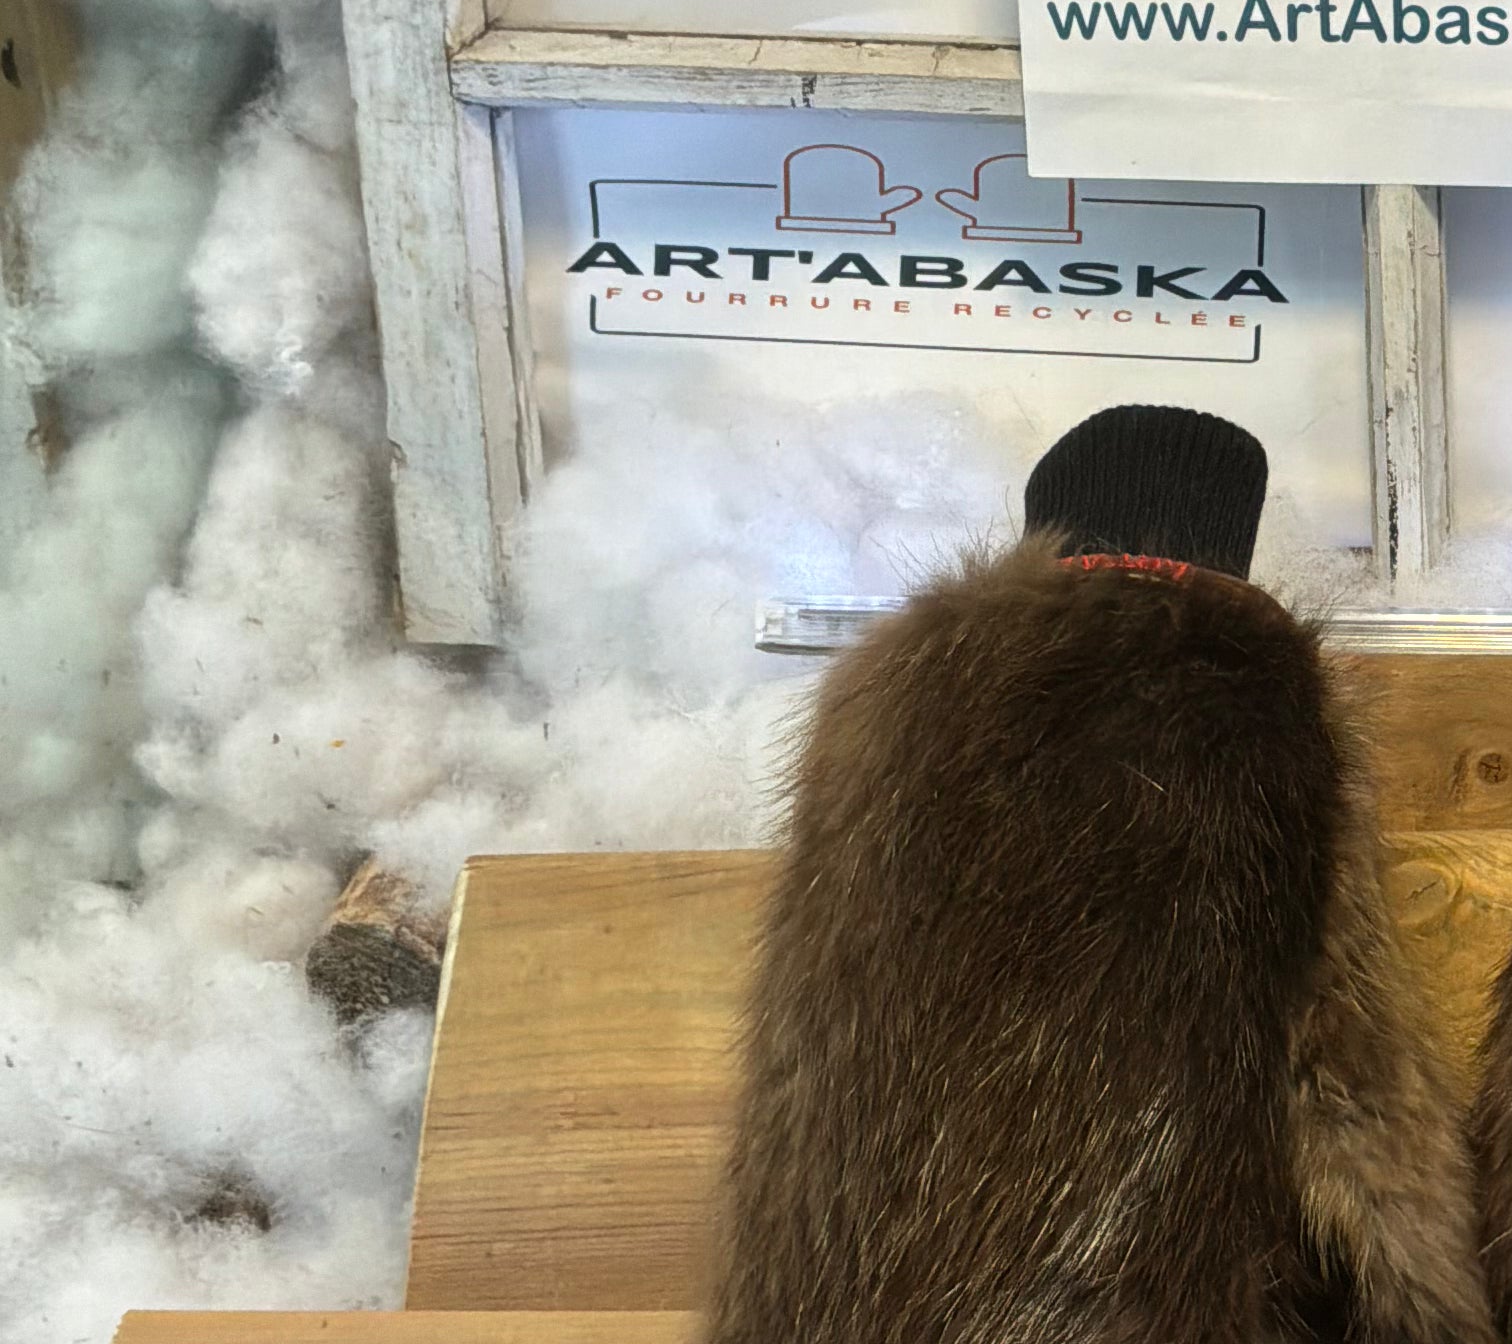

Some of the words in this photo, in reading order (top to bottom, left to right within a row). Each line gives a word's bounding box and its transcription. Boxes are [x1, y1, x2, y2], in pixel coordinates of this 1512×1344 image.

[564, 240, 1291, 304] ART'ABASKA
[606, 287, 912, 314] FOURRURE
[954, 302, 1247, 329] RECYCLÉE
